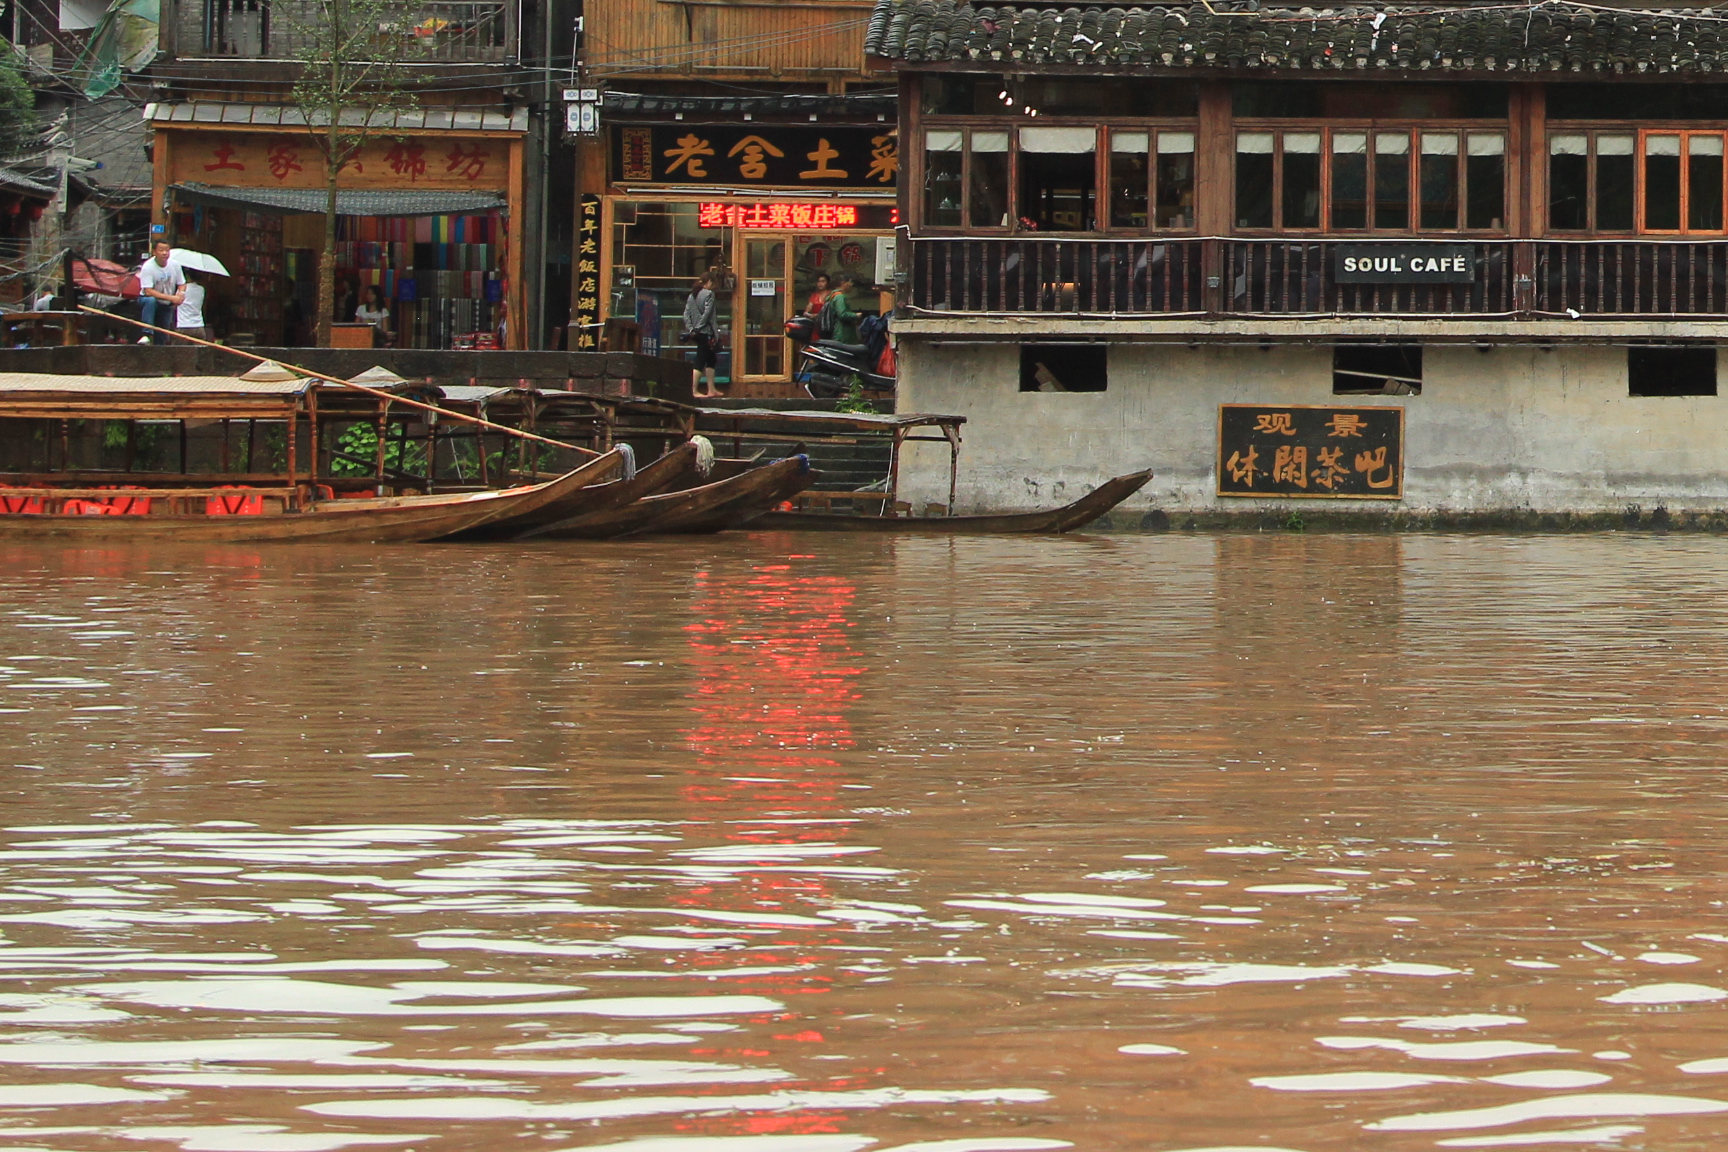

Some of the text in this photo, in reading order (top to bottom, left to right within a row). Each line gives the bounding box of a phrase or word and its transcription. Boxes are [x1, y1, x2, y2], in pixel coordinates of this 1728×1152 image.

[1344, 254, 1466, 273] SOUL CAFÉ
[1253, 413, 1368, 438] 观景
